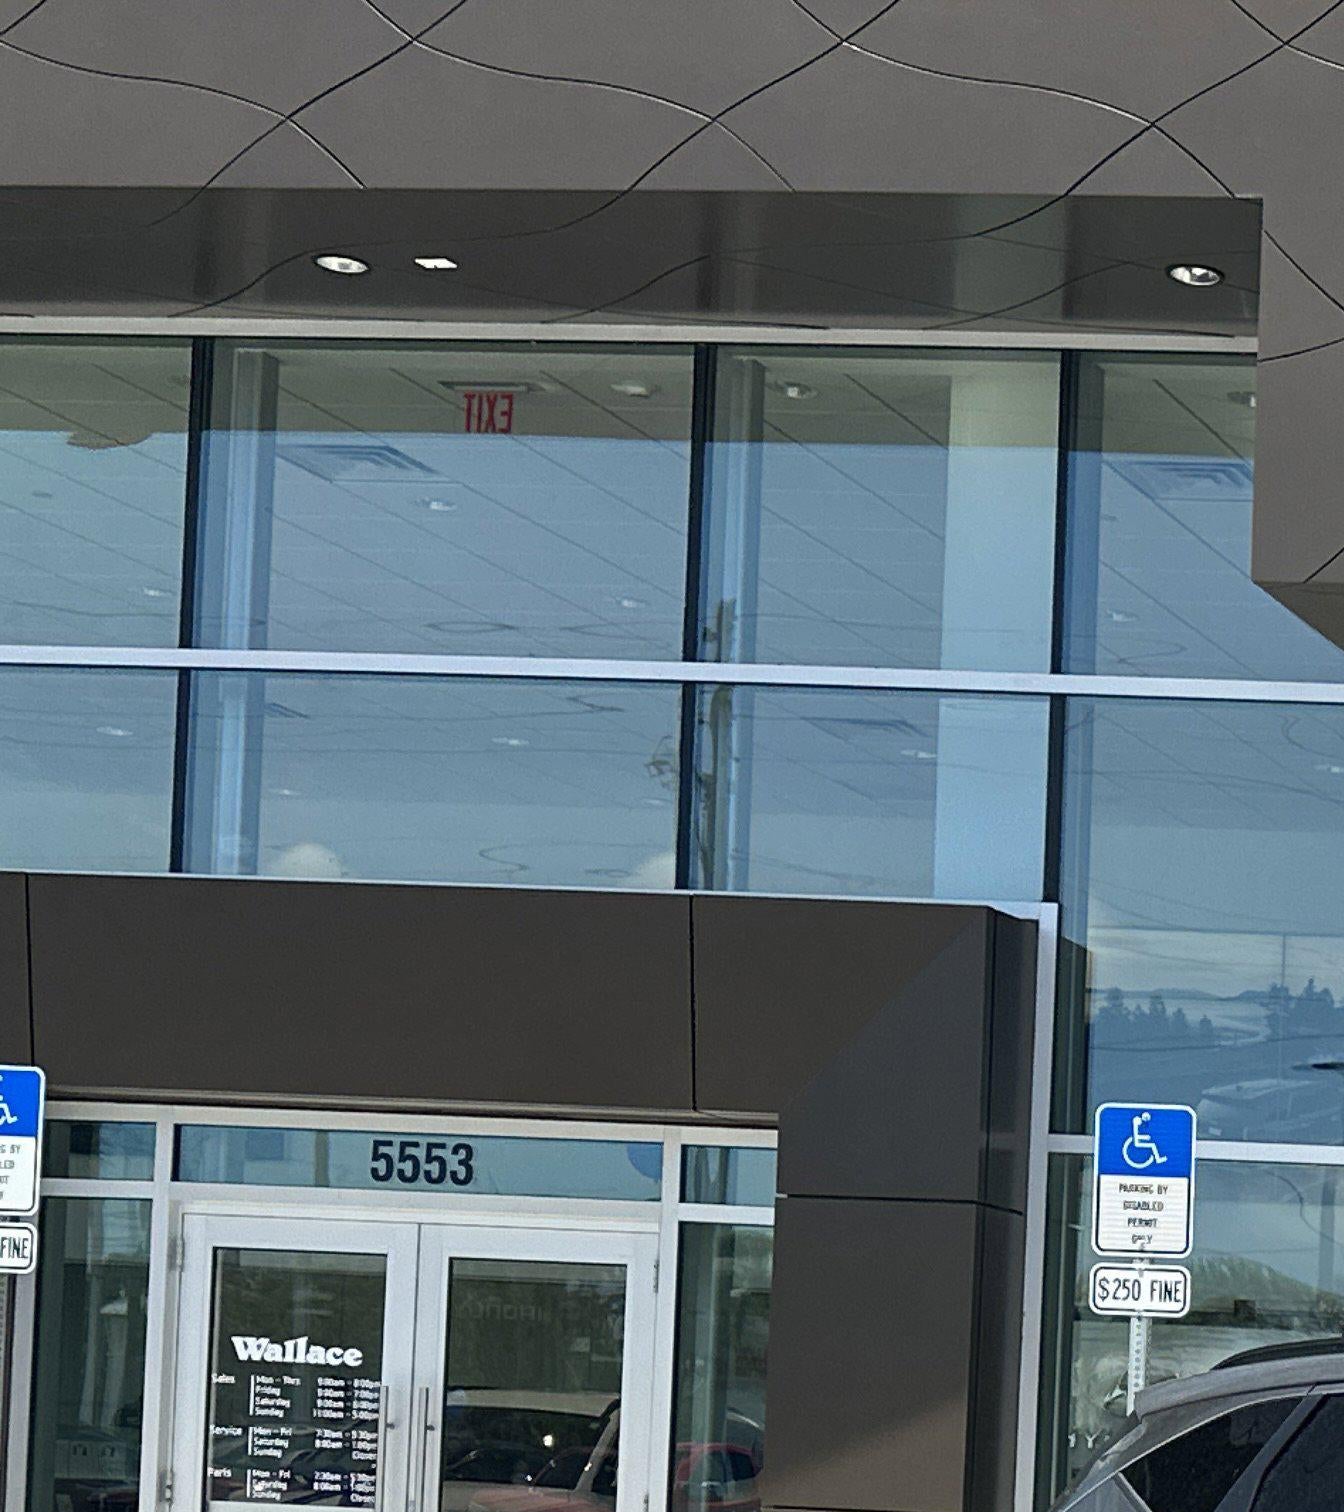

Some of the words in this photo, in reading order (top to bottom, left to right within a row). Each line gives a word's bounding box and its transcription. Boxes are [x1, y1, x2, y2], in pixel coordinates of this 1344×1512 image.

[371, 1140, 474, 1186] 5553
[1119, 1182, 1154, 1194] PARKING
[1157, 1184, 1168, 1194] BY
[1122, 1201, 1164, 1211] DISABLED
[1127, 1217, 1158, 1228] PERMIT
[0, 1236, 29, 1259] FINE
[1098, 1275, 1141, 1303] $250
[1150, 1279, 1183, 1303] FINE
[231, 1336, 363, 1367] Wallace
[212, 1373, 235, 1384] Sales
[255, 1407, 284, 1418] Sunday
[209, 1424, 242, 1436] Service
